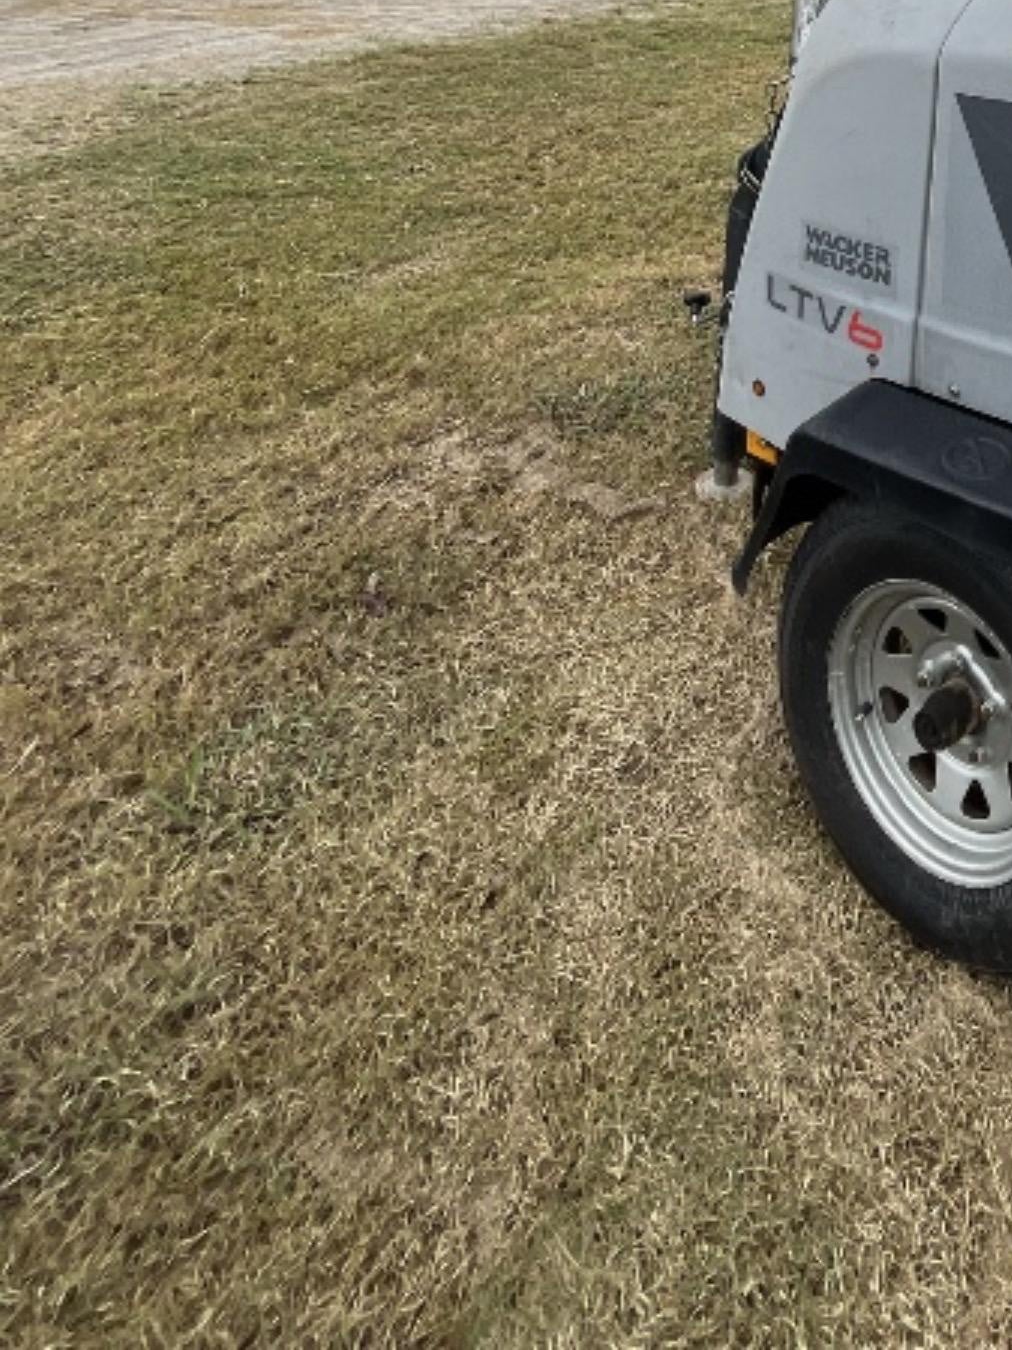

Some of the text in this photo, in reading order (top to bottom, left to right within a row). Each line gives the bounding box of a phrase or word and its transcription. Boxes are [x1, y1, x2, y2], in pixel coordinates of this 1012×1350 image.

[804, 244, 892, 286] NEUSON
[805, 224, 891, 264] WACKER
[766, 274, 883, 351] LTV6
